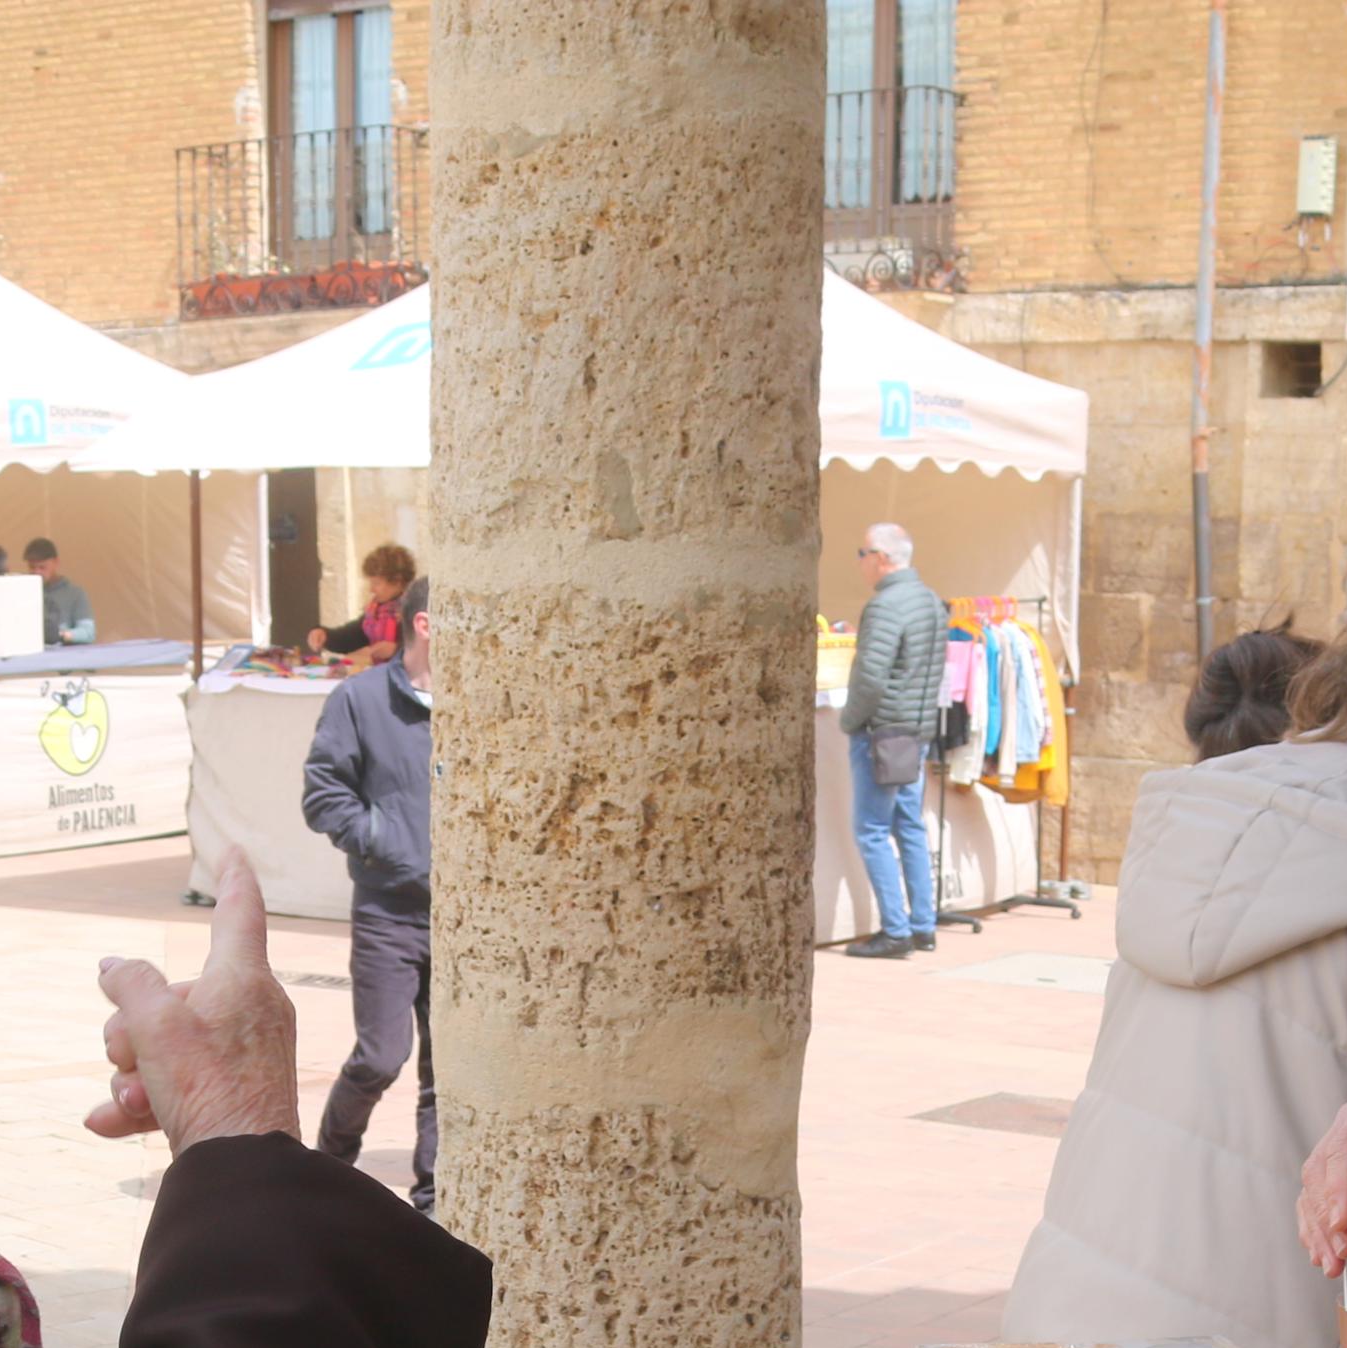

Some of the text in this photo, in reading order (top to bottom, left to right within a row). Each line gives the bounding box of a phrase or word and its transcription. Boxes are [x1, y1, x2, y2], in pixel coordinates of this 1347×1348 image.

[48, 783, 115, 808] Alimentos
[57, 804, 136, 832] de PALENCIA
